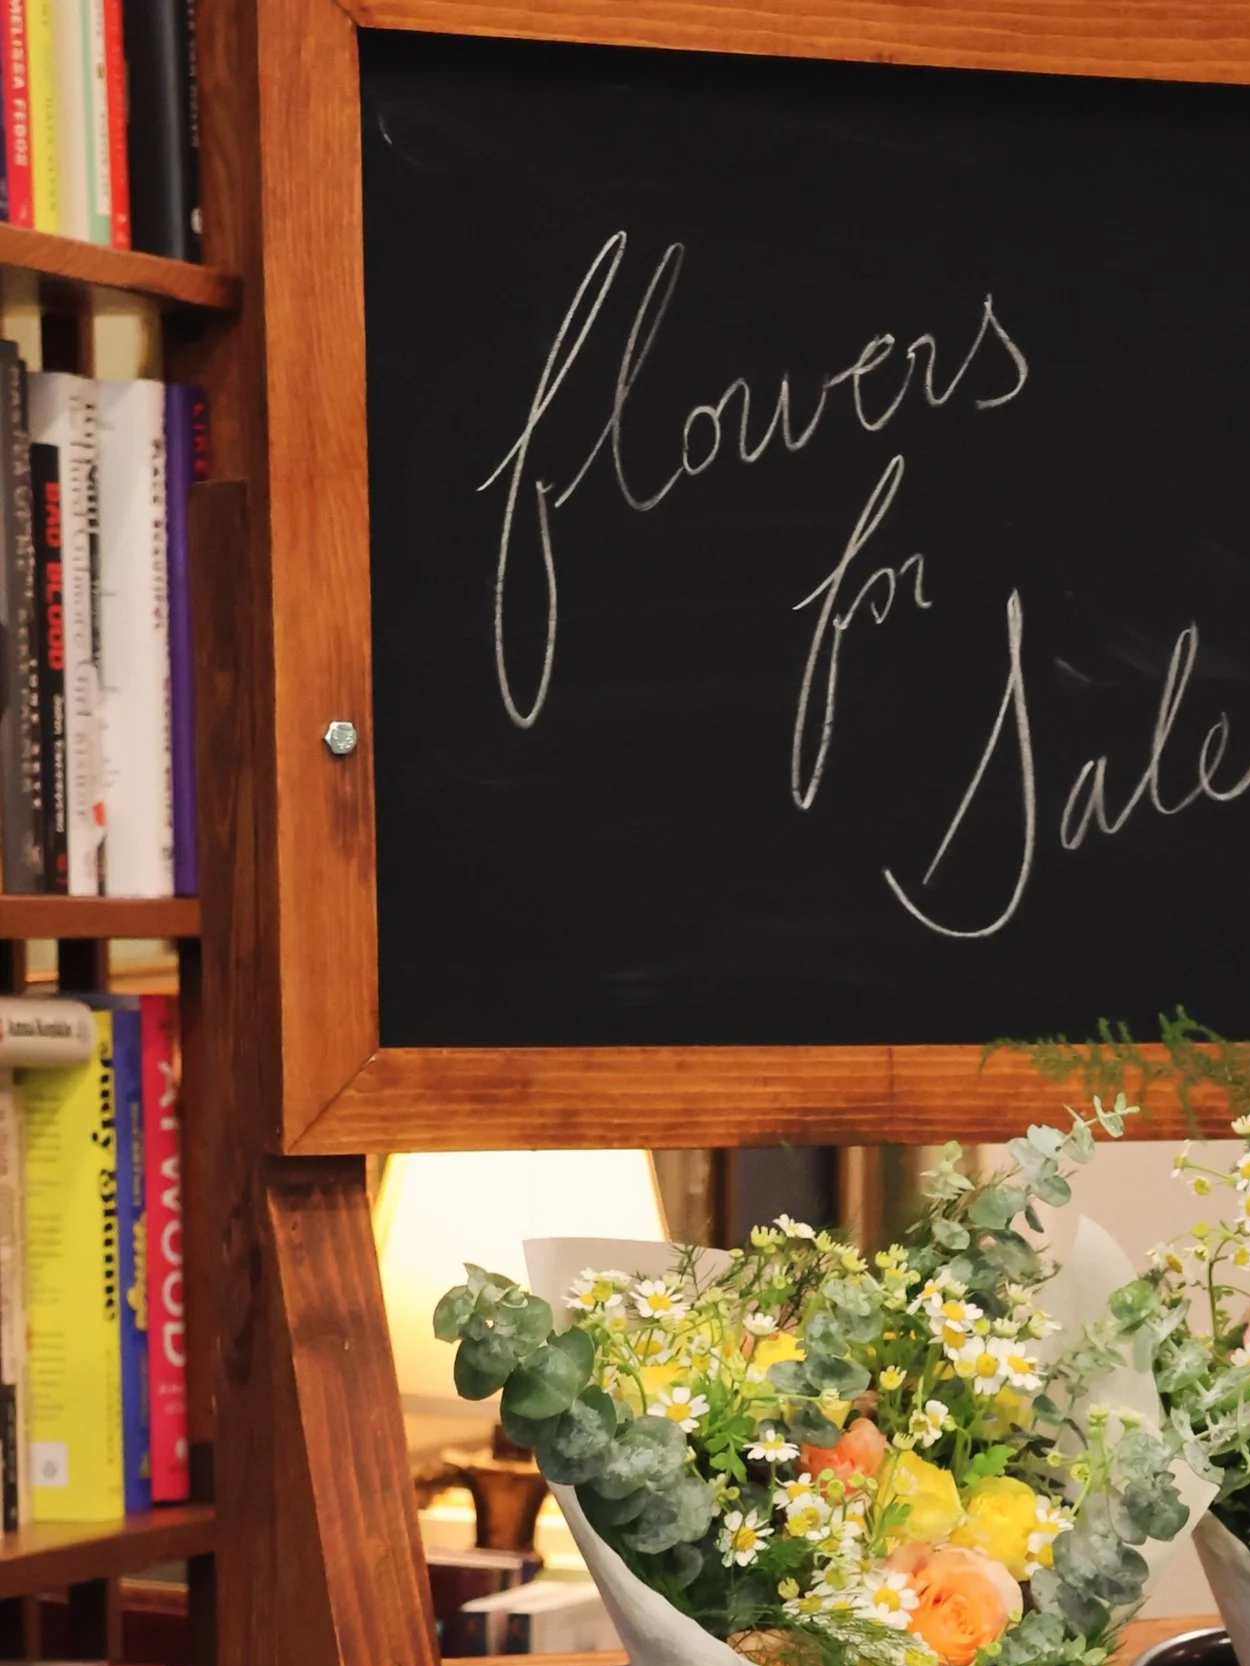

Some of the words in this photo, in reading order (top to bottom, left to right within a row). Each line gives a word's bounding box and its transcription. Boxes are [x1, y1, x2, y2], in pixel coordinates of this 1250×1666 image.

[45, 481, 62, 547] BAD
[476, 230, 1029, 728] flowers
[46, 562, 65, 670] BLOOD
[792, 455, 932, 810] for
